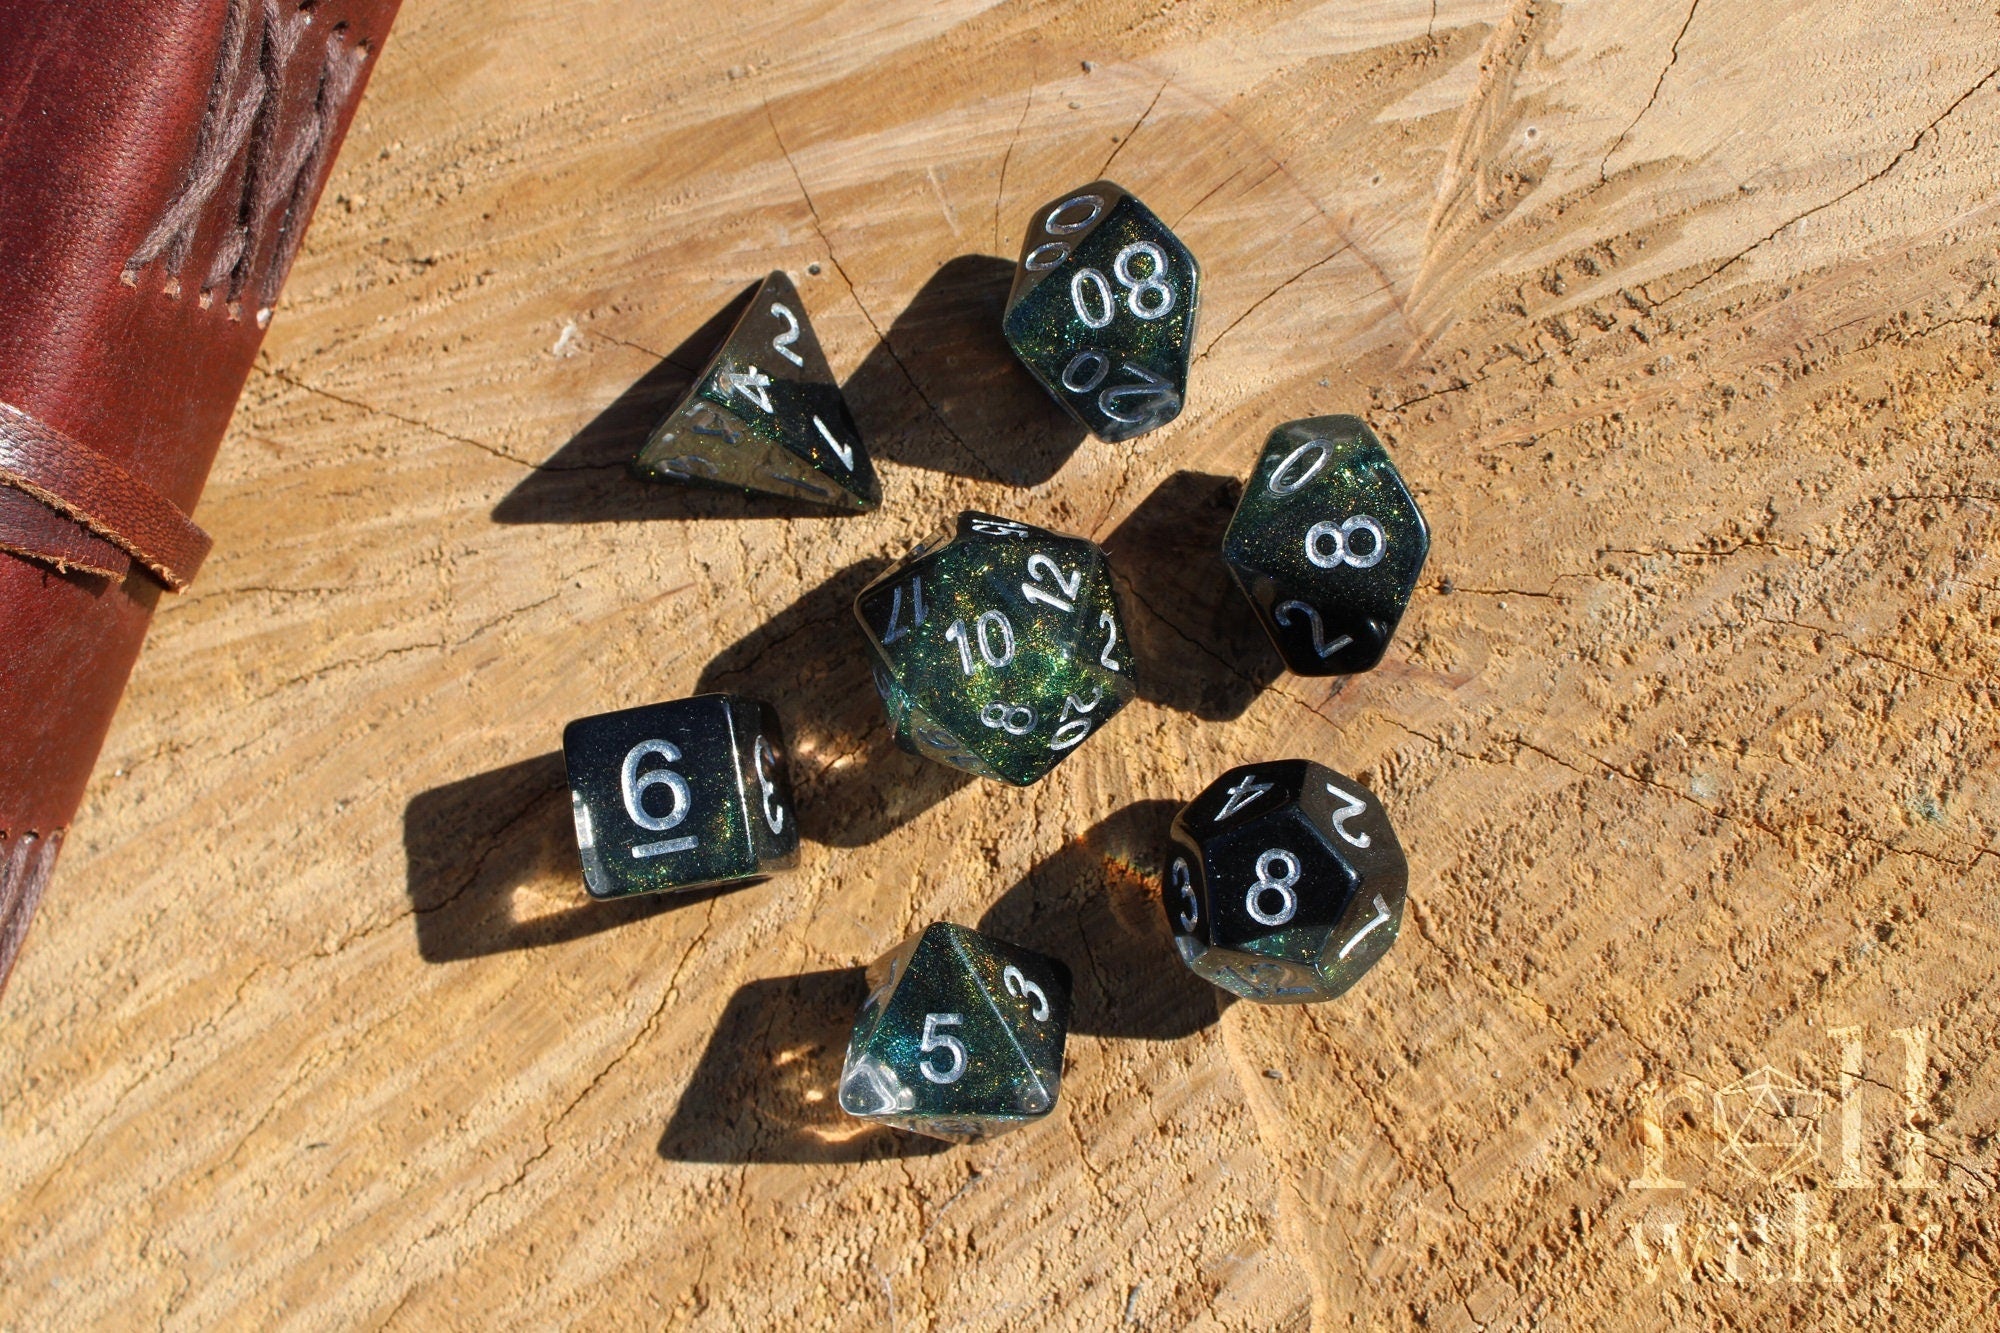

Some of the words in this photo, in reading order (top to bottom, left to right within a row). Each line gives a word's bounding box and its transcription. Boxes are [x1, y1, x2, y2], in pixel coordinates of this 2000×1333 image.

[1070, 240, 1176, 329] 80
[771, 302, 804, 367] 2
[812, 414, 854, 472] 1
[1268, 438, 1335, 495] 0
[1304, 514, 1387, 569] 8
[1021, 553, 1082, 613] 12
[945, 609, 1016, 676] 10
[1099, 611, 1121, 671] 2
[980, 700, 1039, 735] 8
[1050, 686, 1104, 751] 20
[620, 738, 693, 832] 6
[1213, 774, 1275, 822] 4
[1326, 782, 1372, 849] 2
[1172, 857, 1198, 932] 3
[1245, 848, 1302, 927] 8
[1003, 965, 1051, 1022] 3
[919, 1012, 968, 1084] 5
